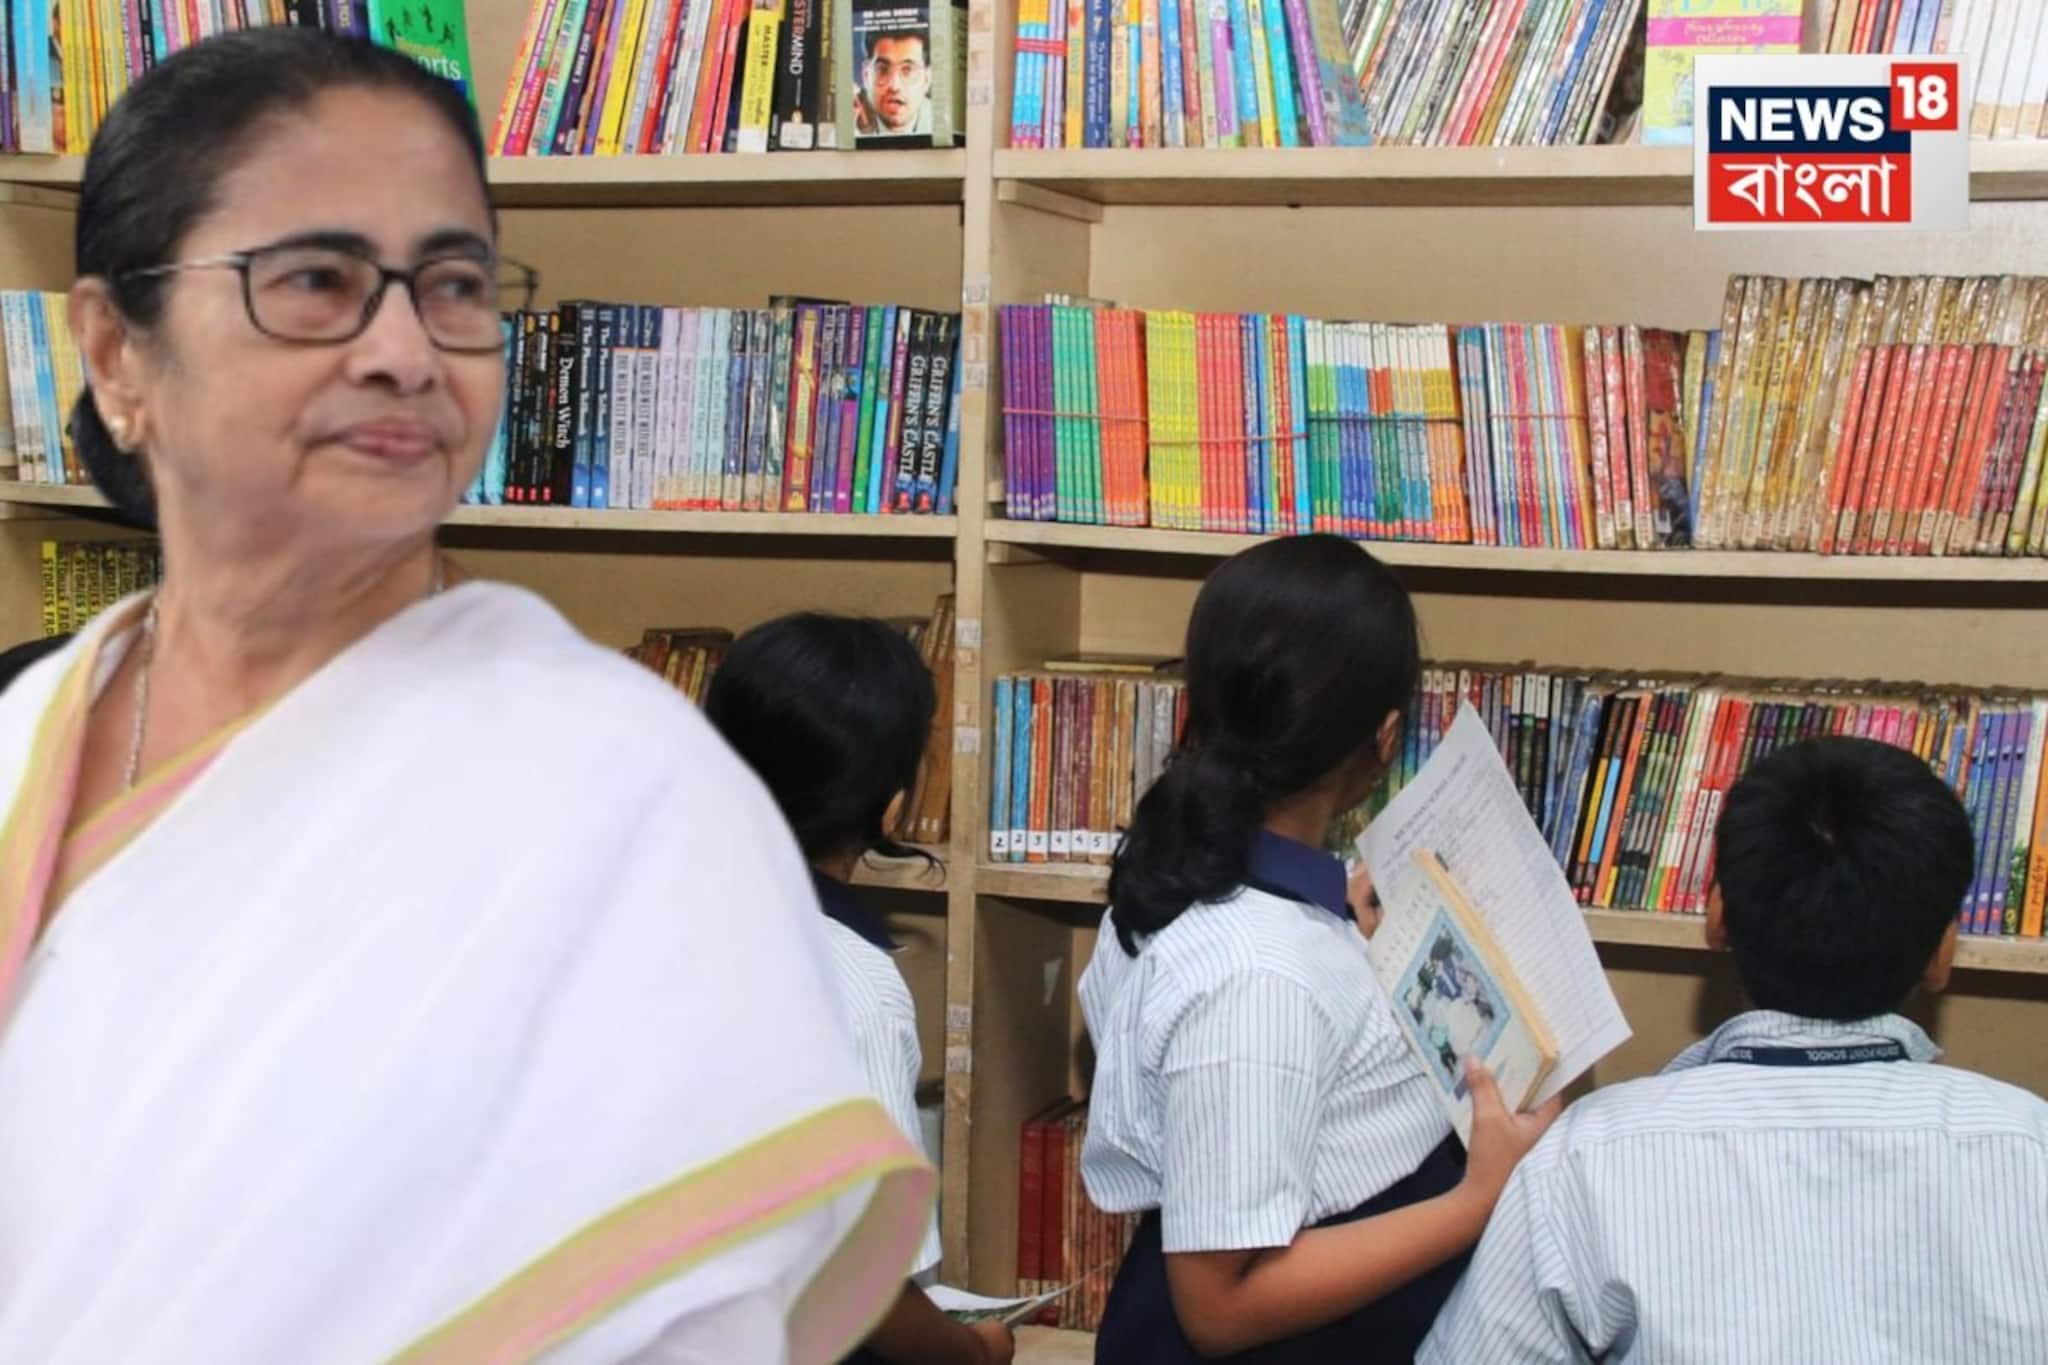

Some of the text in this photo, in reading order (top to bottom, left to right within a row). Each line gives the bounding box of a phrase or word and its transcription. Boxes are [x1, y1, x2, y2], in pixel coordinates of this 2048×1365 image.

[555, 356, 575, 449] Demon Witch
[906, 355, 927, 426] GRIFFIN'S
[926, 355, 948, 427] GRIFFIN'S
[900, 428, 921, 482] CASTLE
[920, 429, 943, 484] CASTLE
[1093, 835, 1103, 848] 5
[1805, 1049, 1848, 1062] SCHOOL
